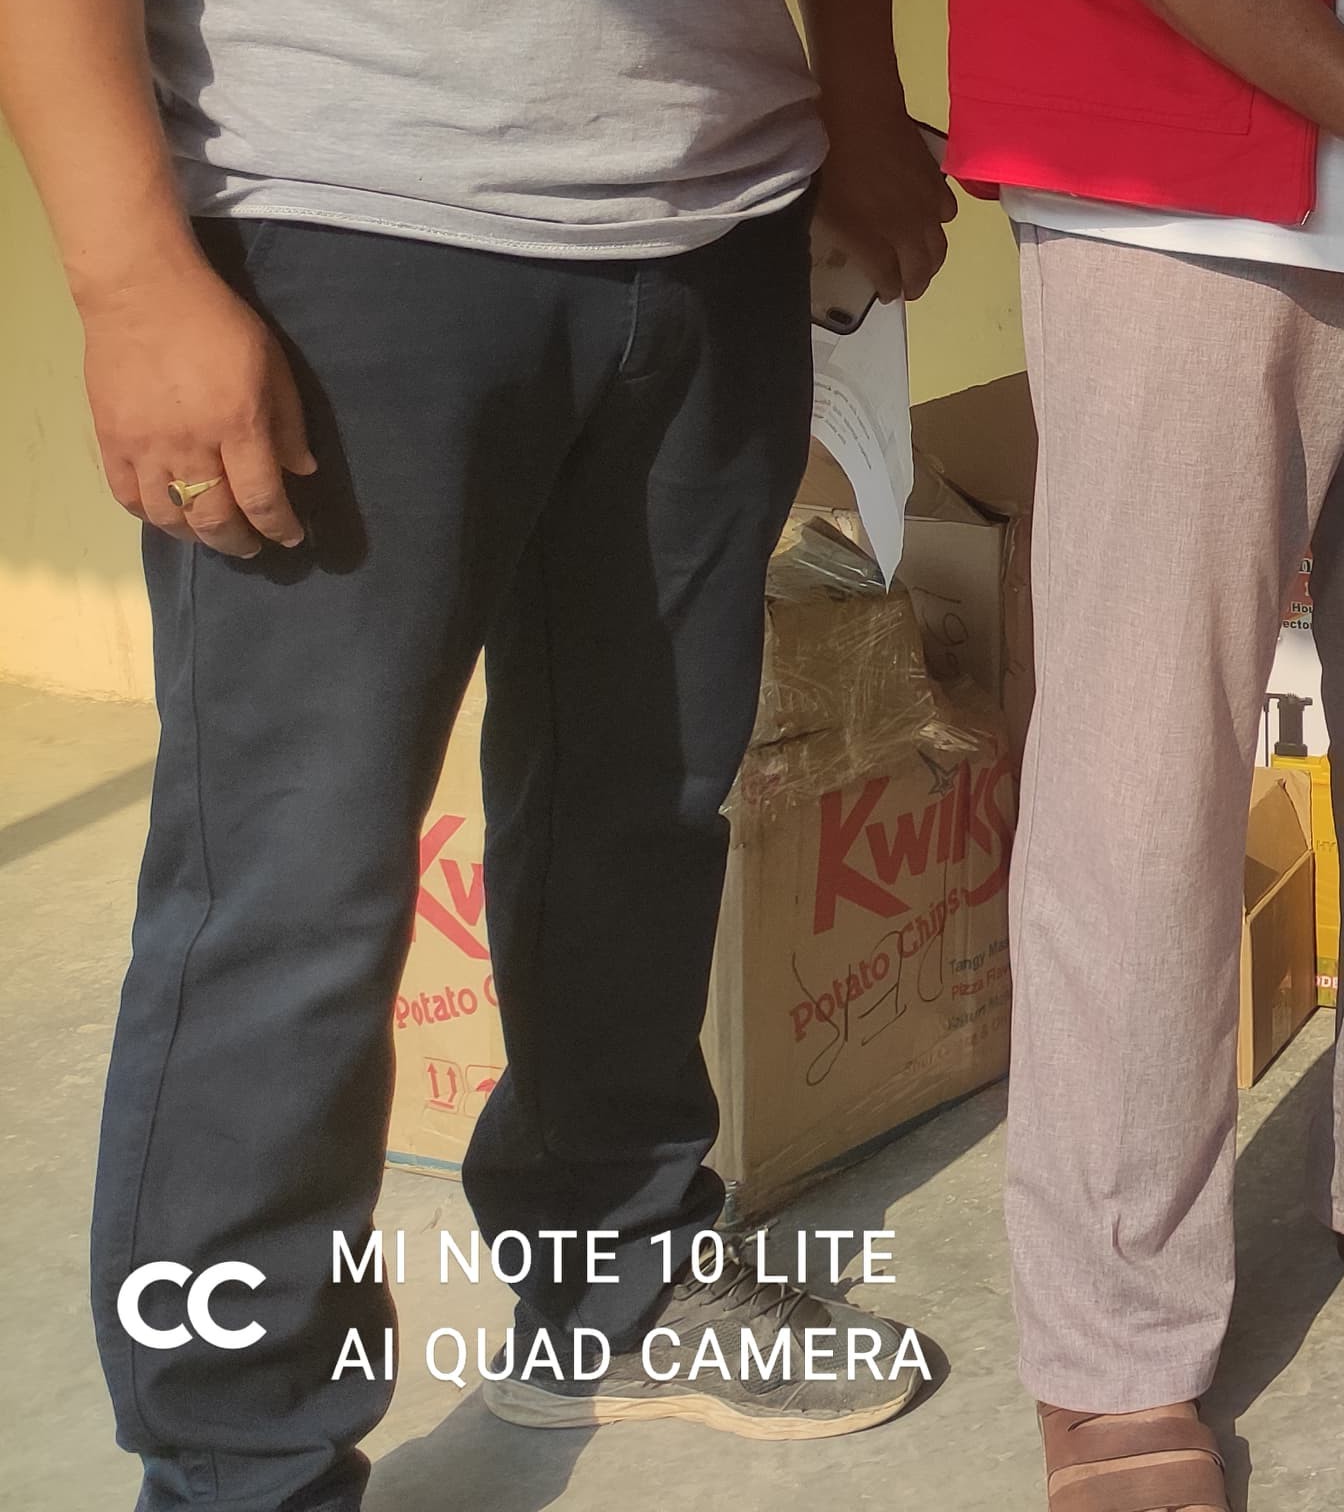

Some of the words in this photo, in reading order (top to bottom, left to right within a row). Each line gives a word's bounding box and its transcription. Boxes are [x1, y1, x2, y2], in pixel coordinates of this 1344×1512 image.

[394, 985, 478, 1029] Potato
[789, 952, 890, 1043] Potato
[897, 888, 961, 959] Chips
